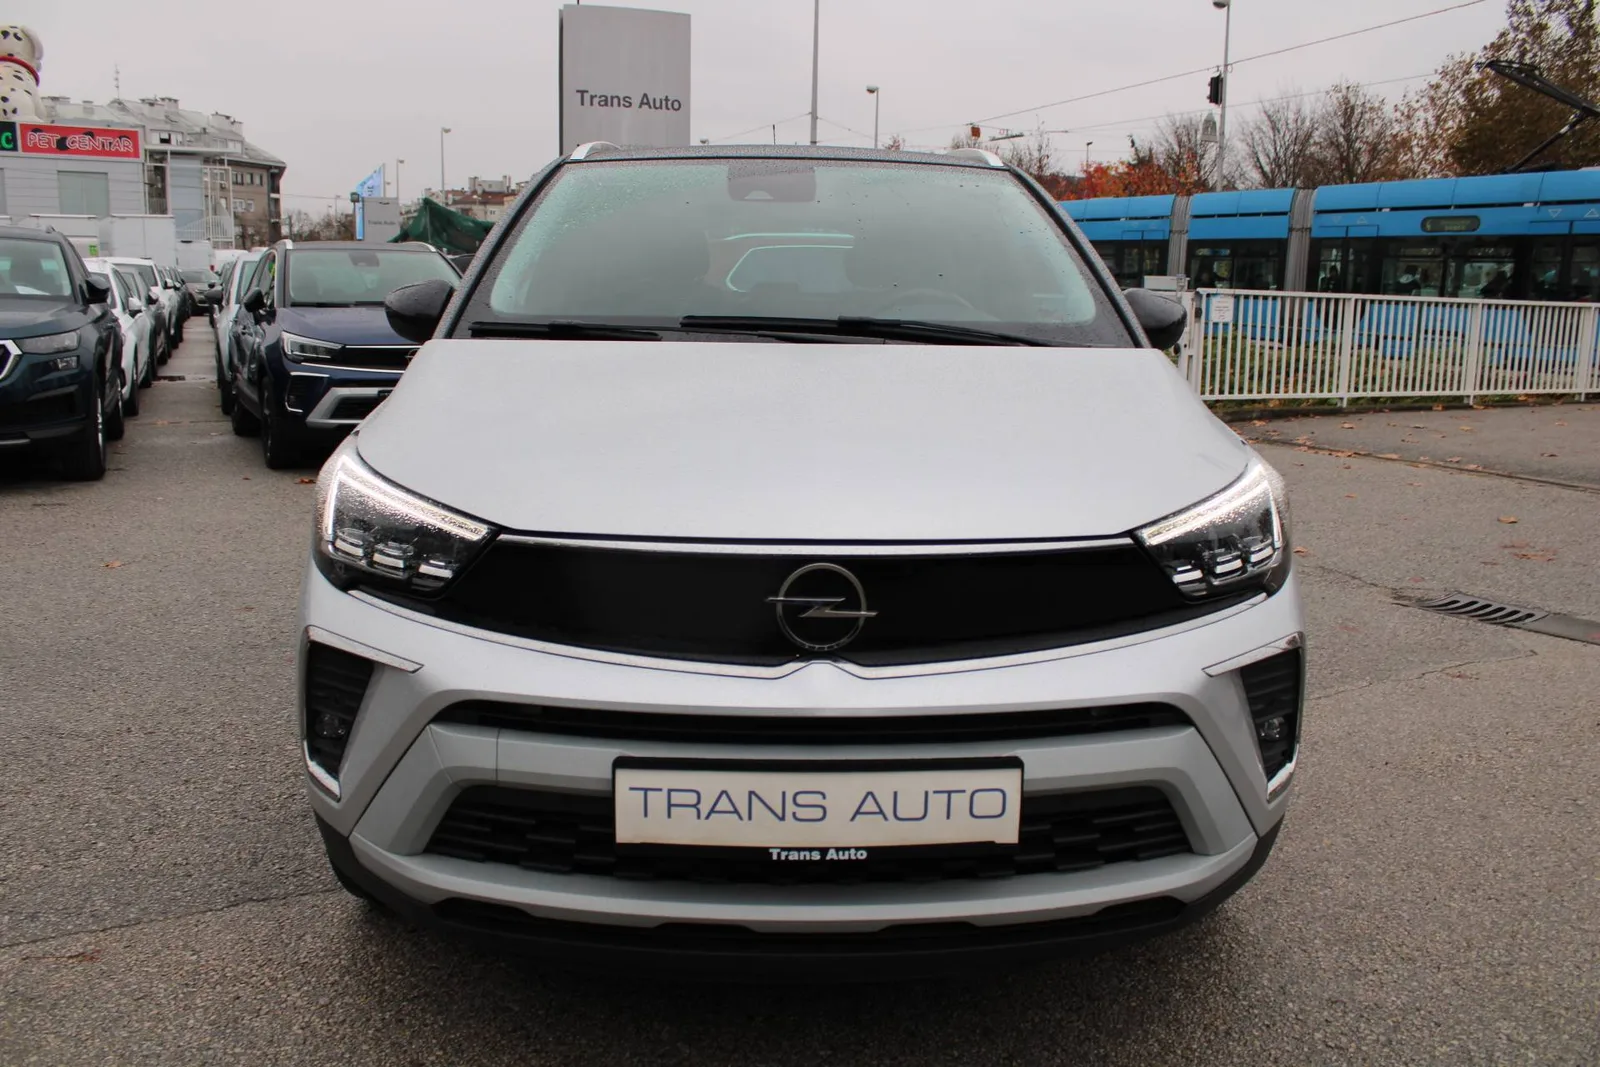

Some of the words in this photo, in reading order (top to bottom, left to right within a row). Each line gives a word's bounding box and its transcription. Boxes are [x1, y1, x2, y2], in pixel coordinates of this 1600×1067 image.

[576, 89, 633, 109] Trans
[638, 92, 682, 112] Auto
[27, 132, 60, 148] PET
[66, 134, 133, 152] CENTAR
[628, 786, 828, 823] TRANS
[850, 788, 1007, 822] AUTO
[769, 848, 821, 861] Trans
[826, 848, 867, 861] Auto
